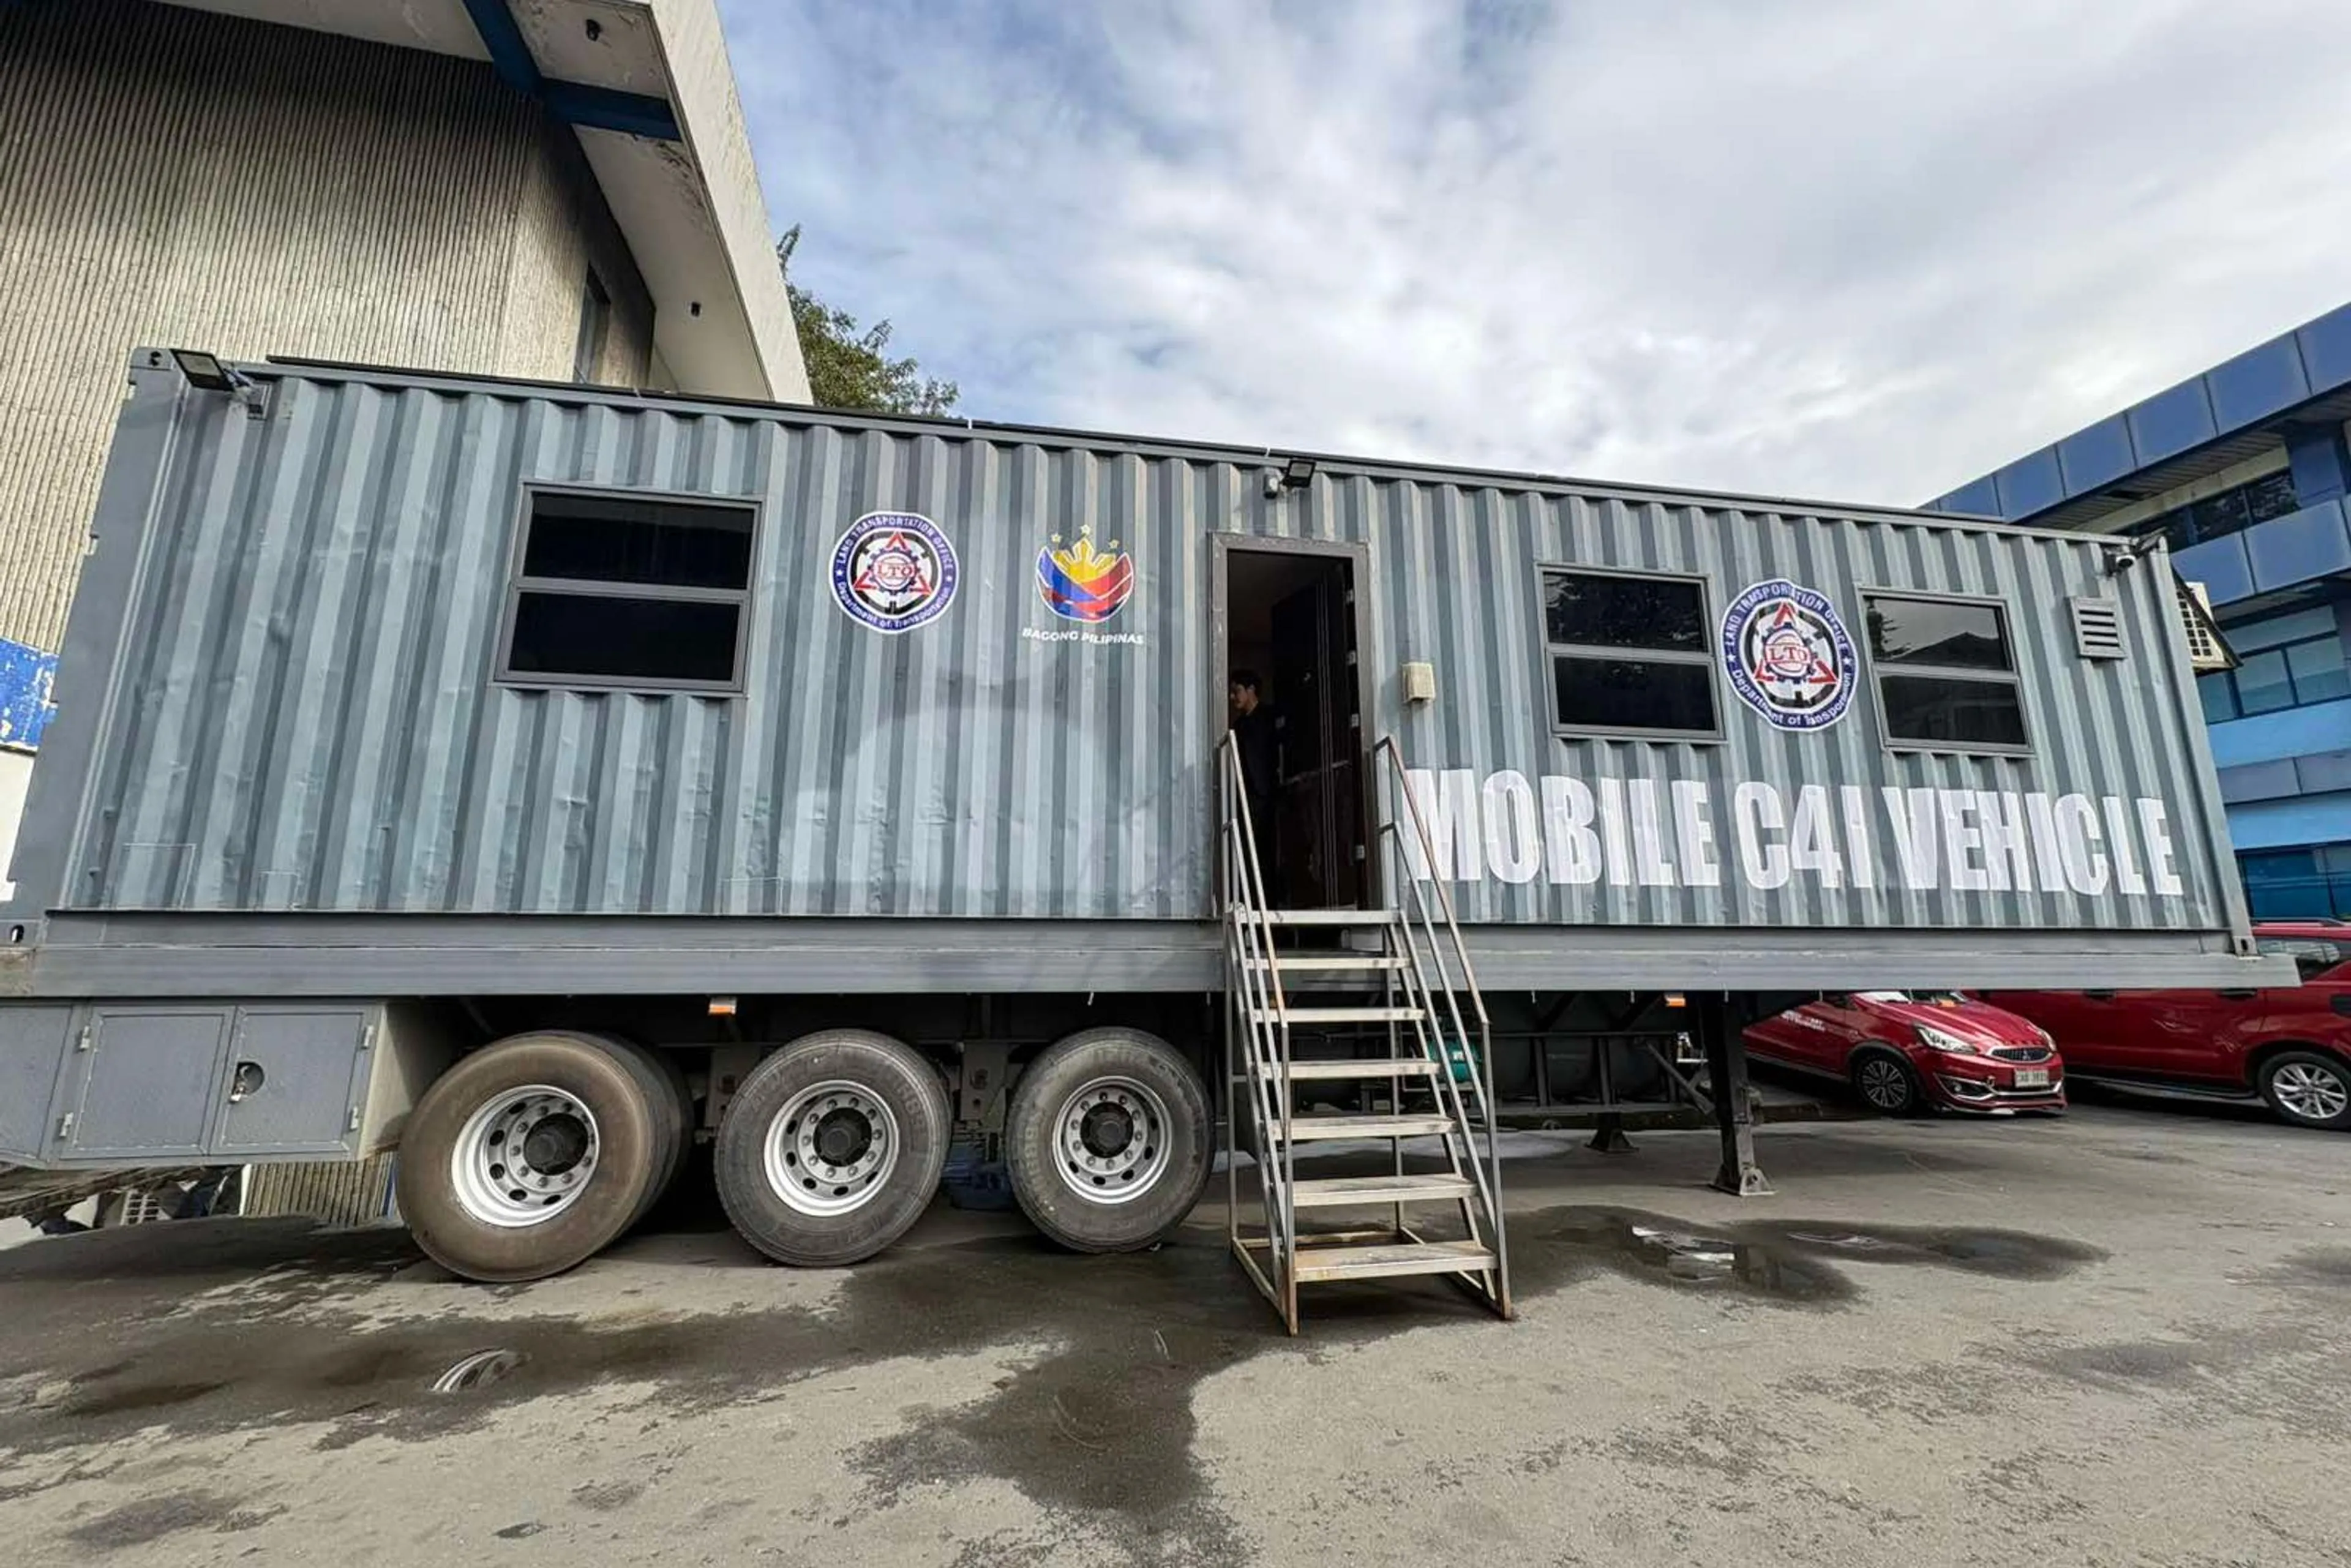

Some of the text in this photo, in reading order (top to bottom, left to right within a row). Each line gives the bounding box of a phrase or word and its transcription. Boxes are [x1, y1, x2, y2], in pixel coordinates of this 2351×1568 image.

[836, 516, 954, 568] LAND TRANSPORTATION OFFICE
[878, 564, 913, 579] LTO
[1022, 627, 1145, 645] BAGONG PILIPINAS
[1725, 615, 1742, 646] LAND
[1824, 606, 1848, 651] OICE
[1769, 646, 1808, 661] LTO
[1787, 714, 1802, 726] of
[1802, 672, 1852, 726] Tansporon
[1401, 768, 2184, 896] MOBILE C4I VEHICLE
